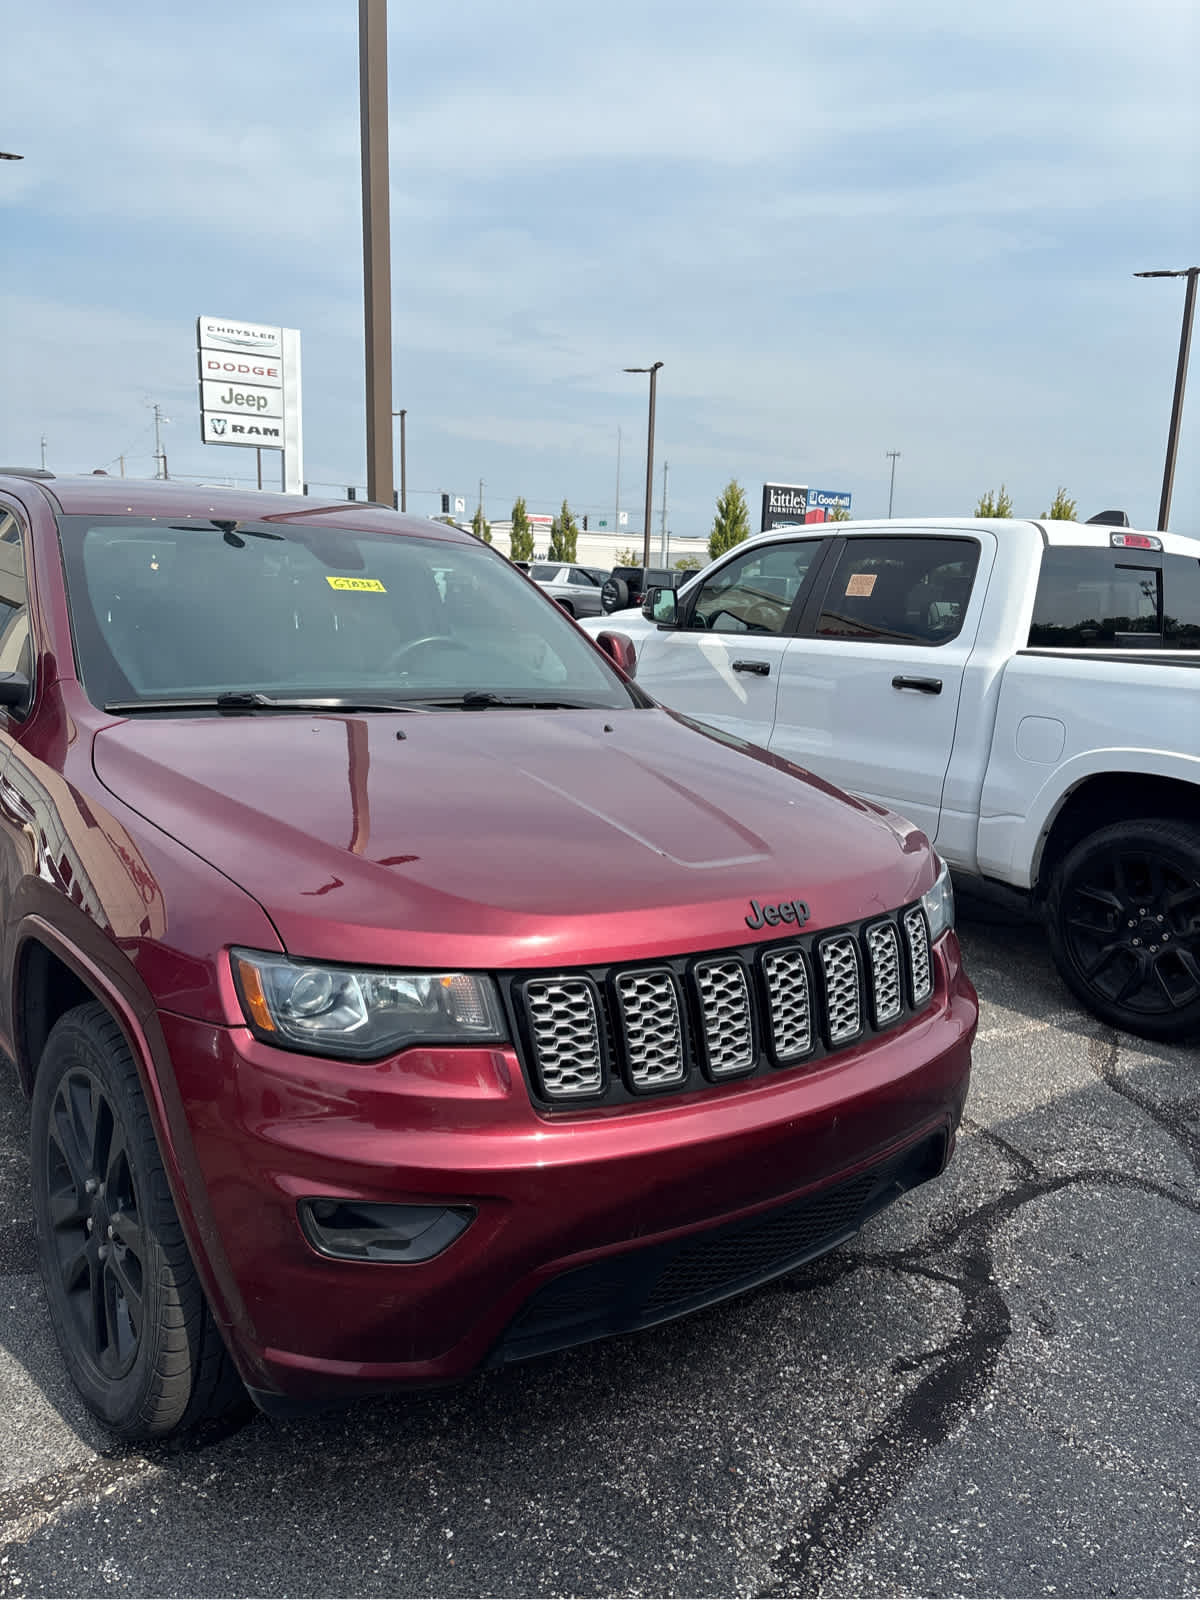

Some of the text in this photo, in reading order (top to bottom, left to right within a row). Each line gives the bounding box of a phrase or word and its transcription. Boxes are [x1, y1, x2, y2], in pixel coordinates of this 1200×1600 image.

[207, 326, 276, 340] CHRYSLER
[207, 361, 279, 377] DODGE
[221, 387, 268, 411] Jeep
[231, 424, 279, 437] RAM
[769, 489, 806, 508] kittle's
[818, 494, 850, 507] Goodwill
[769, 506, 805, 515] FURNITURE
[745, 899, 810, 930] Jeep
